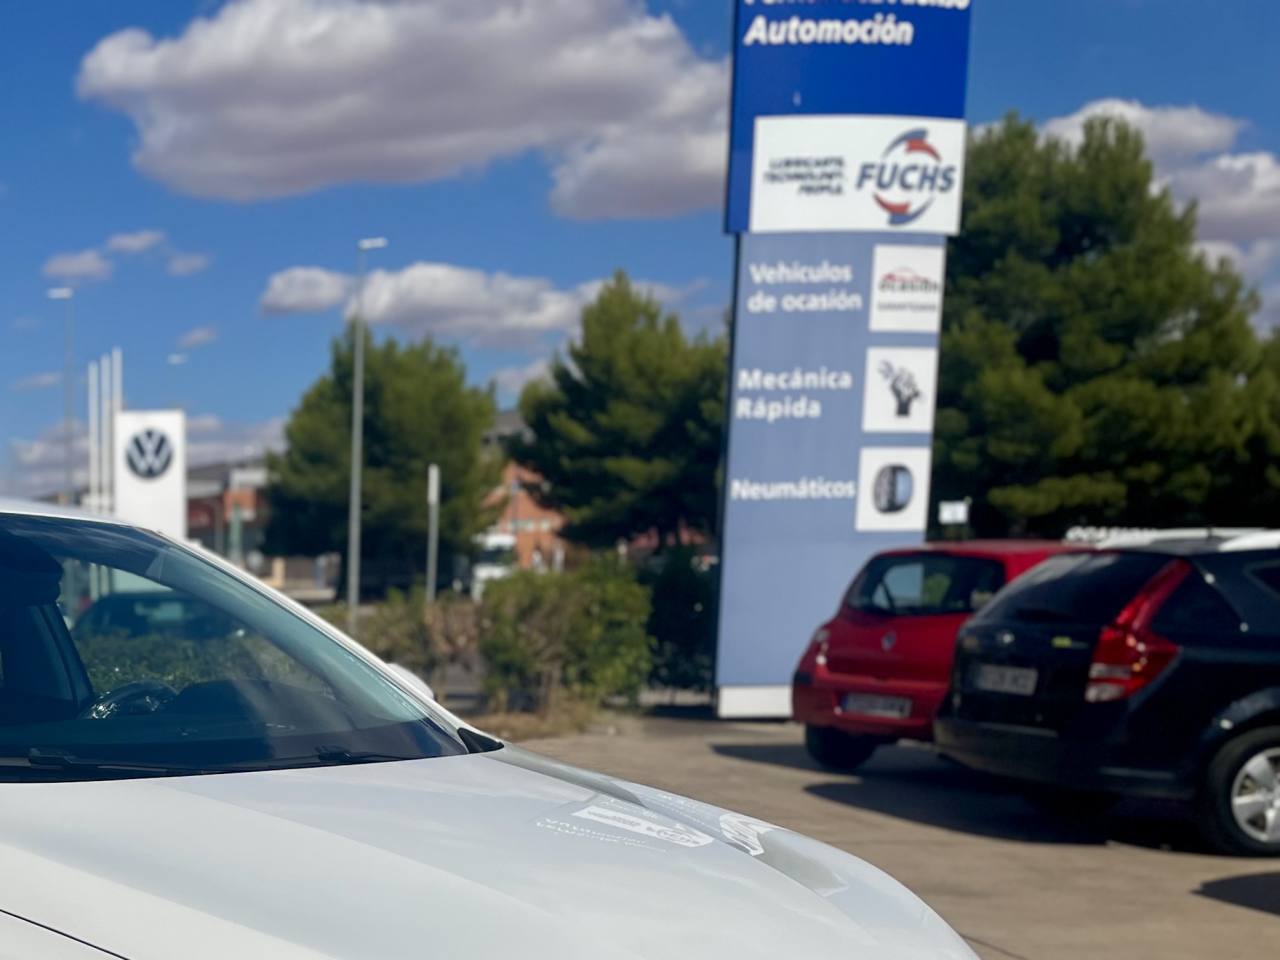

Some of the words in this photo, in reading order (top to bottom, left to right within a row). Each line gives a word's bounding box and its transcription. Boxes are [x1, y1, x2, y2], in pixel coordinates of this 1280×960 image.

[743, 13, 914, 46] Automoción
[856, 162, 956, 192] FUCHS
[747, 290, 778, 313] de
[781, 290, 863, 313] ocasión
[737, 367, 853, 391] Mecánica
[735, 396, 822, 423] Rápida
[730, 477, 856, 500] Neumáticos
